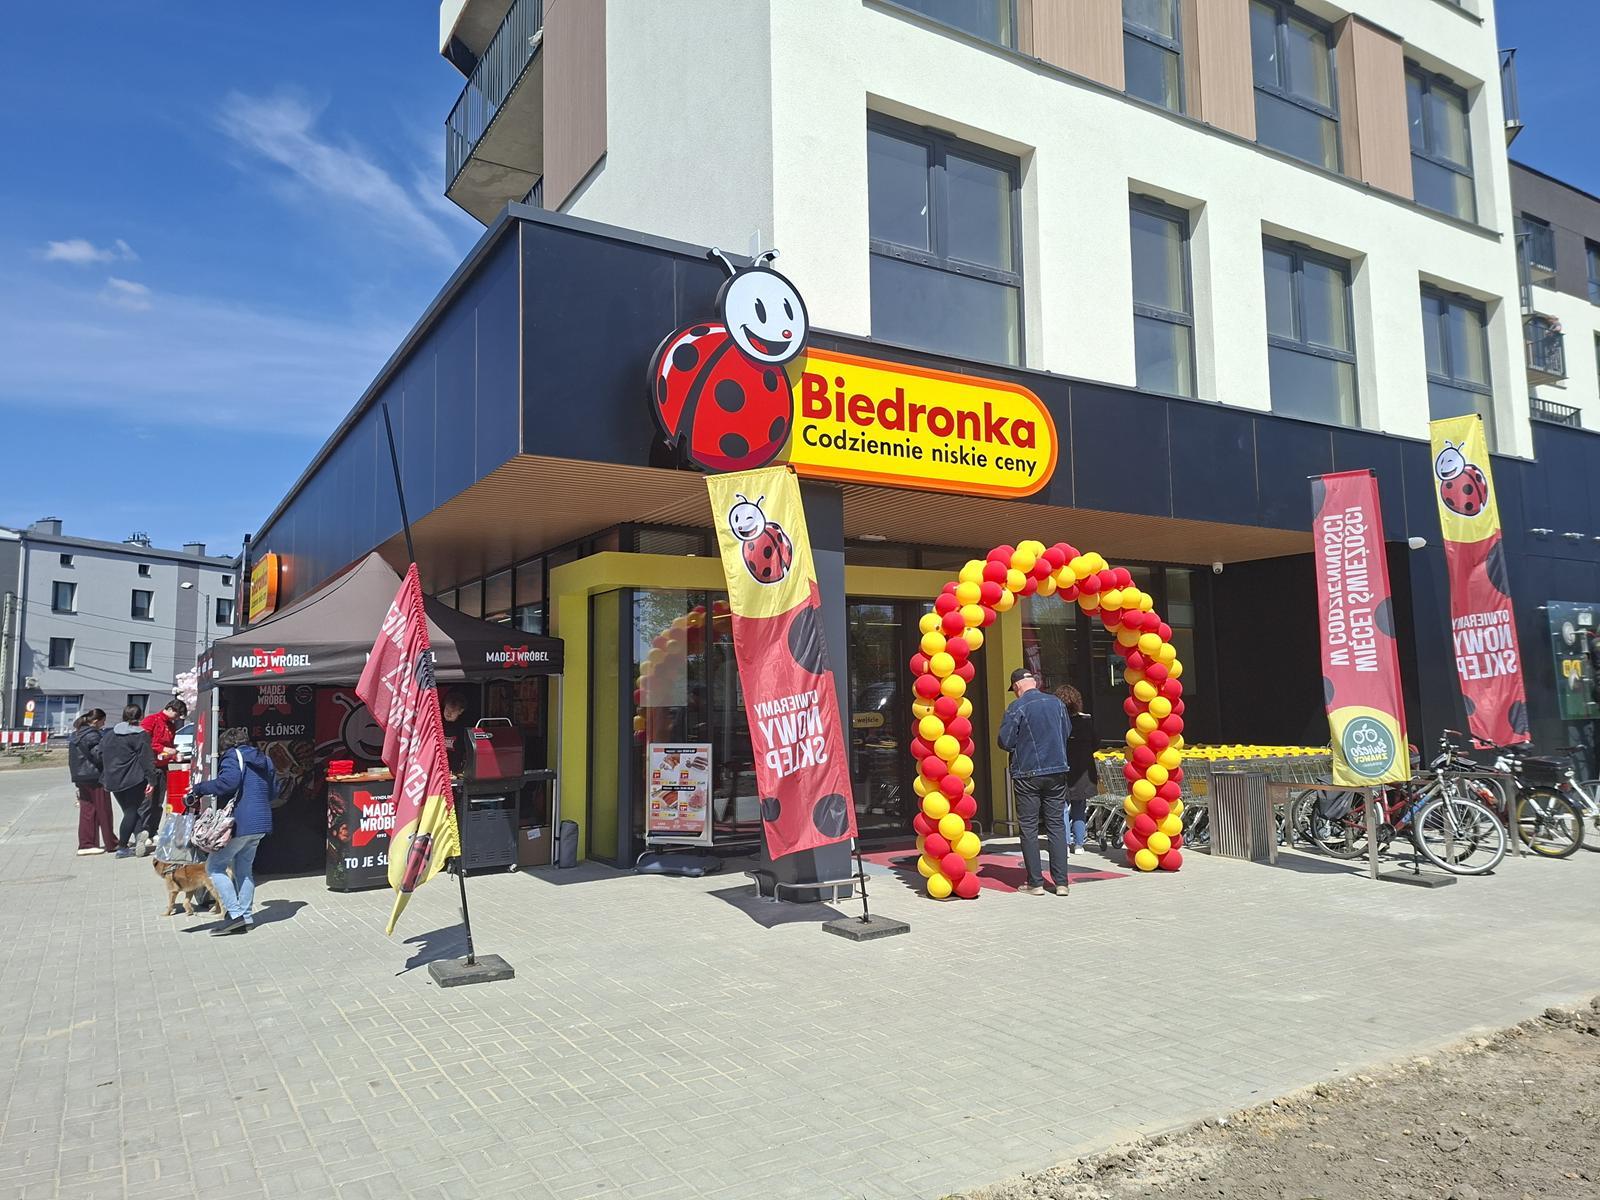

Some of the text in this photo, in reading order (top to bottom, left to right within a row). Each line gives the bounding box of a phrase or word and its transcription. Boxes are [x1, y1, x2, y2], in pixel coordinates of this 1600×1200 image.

[801, 371, 1036, 449] Biedronka
[802, 424, 1037, 478] Codziennie niskie ceny
[231, 653, 311, 668] MADEJ WRÓBEL
[486, 651, 549, 662] MADEJ WRÓBEL
[260, 685, 286, 695] MADEJ
[258, 694, 288, 705] WRÓBEL
[362, 802, 396, 818] MADE
[344, 857, 359, 869] TO
[361, 855, 374, 868] JE
